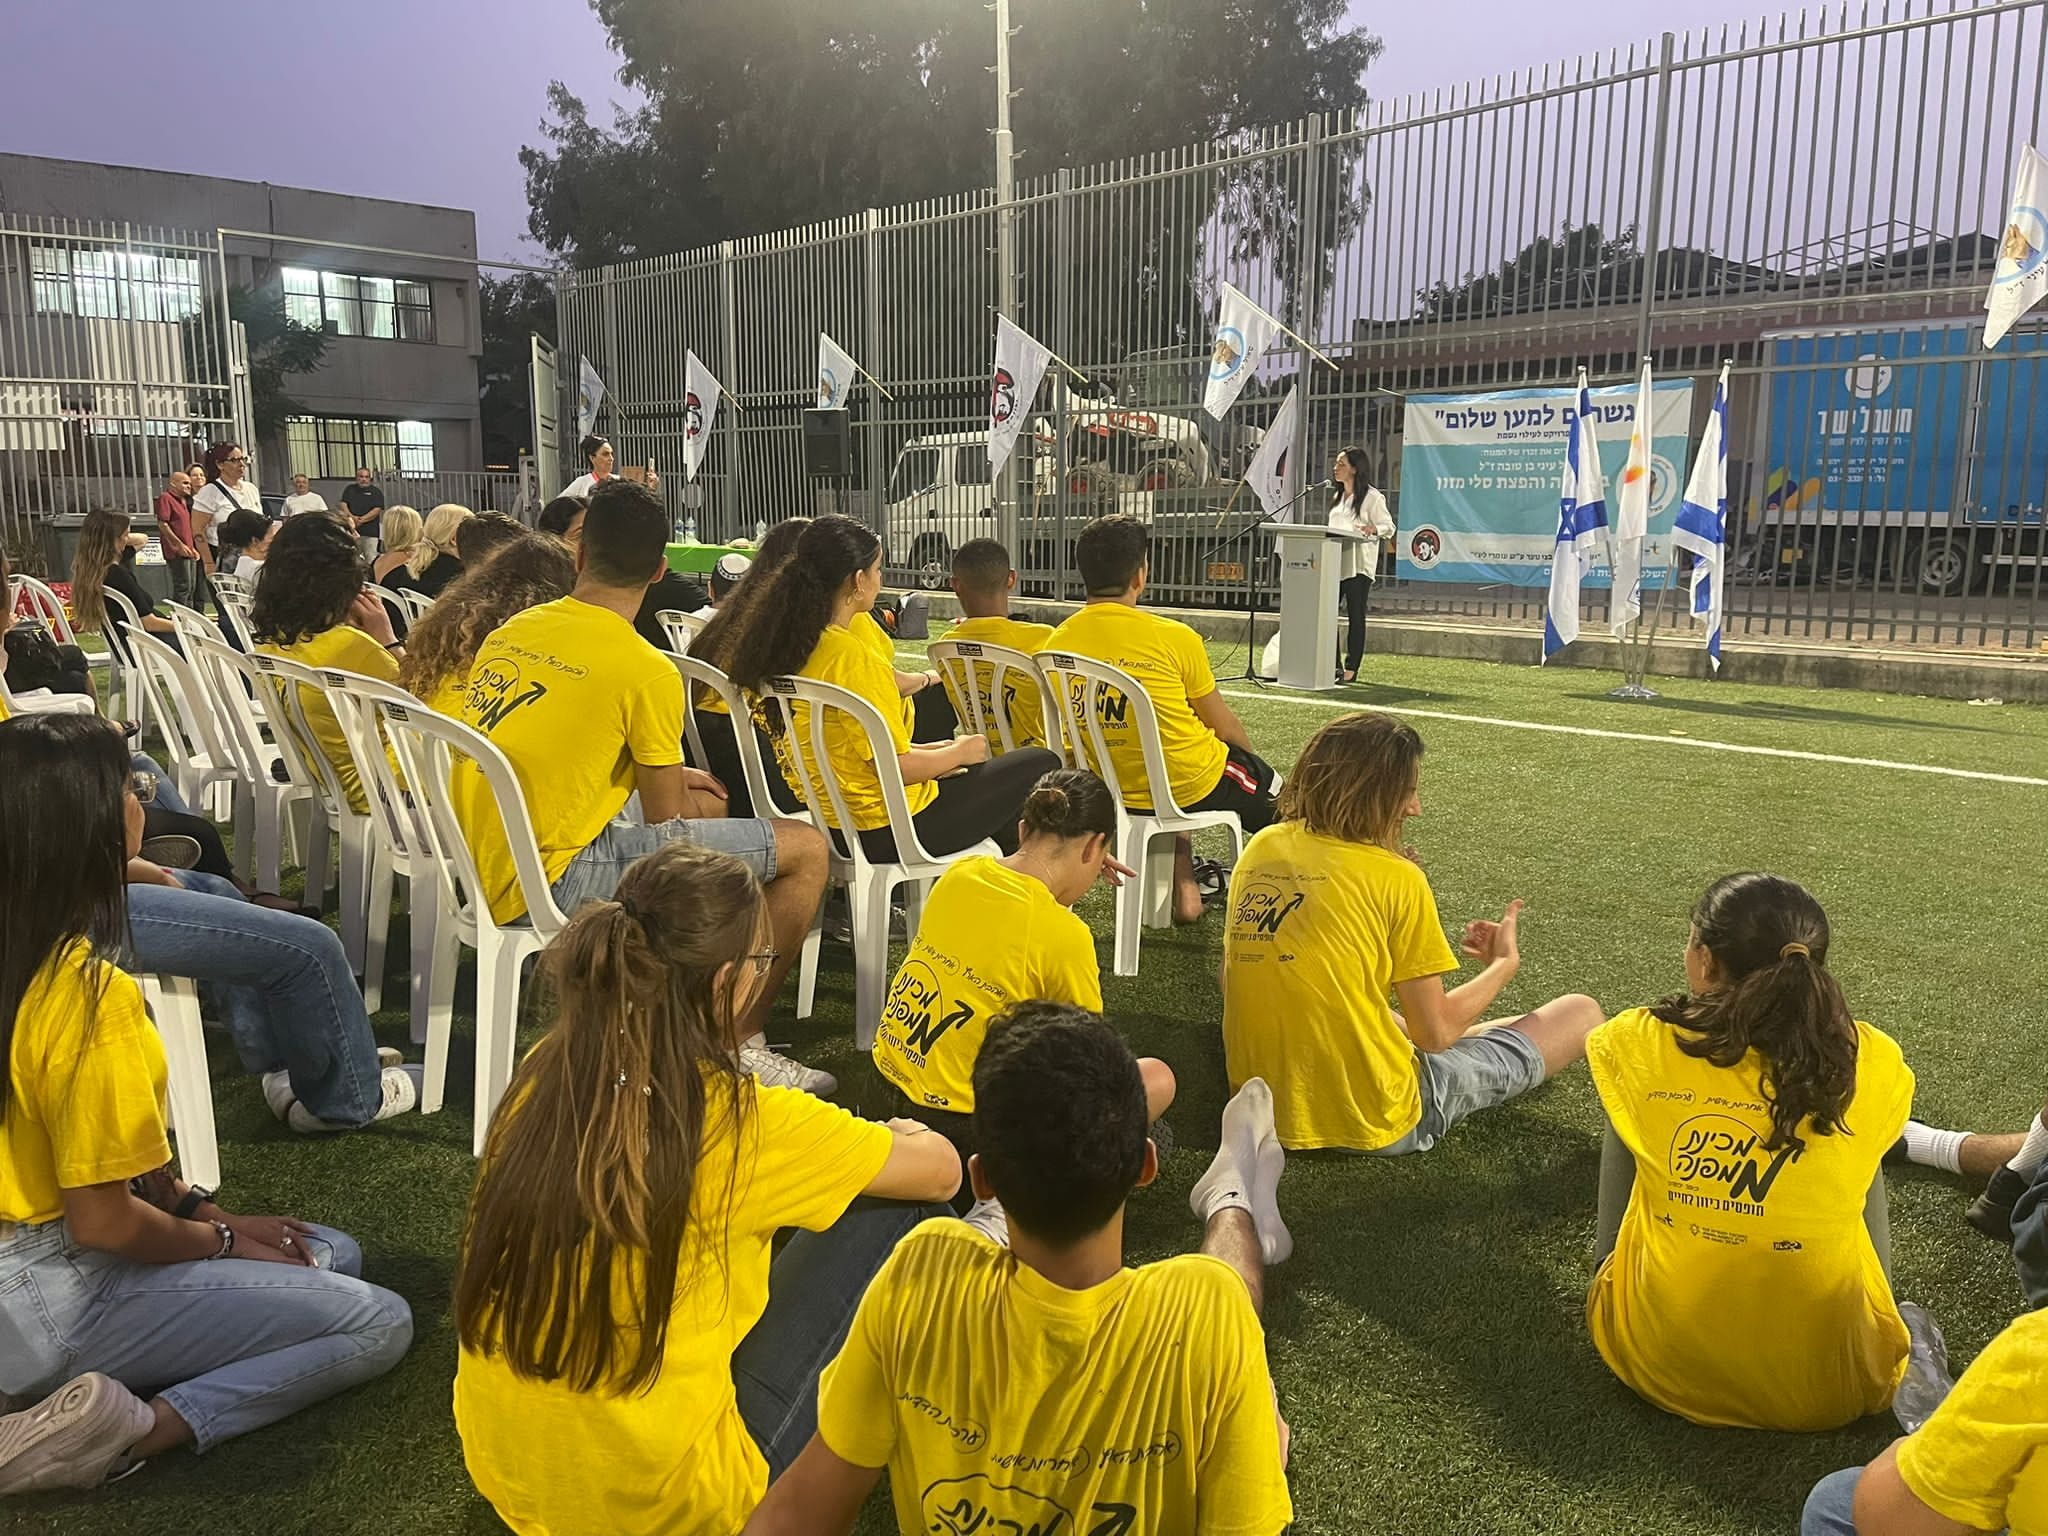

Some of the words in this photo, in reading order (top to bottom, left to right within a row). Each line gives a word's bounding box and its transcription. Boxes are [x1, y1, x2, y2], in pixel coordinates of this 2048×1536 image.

[1504, 403, 1554, 430] למען
[1562, 404, 1635, 424] גשרם
[1436, 475, 1466, 490] מזון
[1469, 474, 1492, 489] סלי
[1496, 476, 1545, 489] והפצת
[1678, 1129, 1758, 1158] מכינת
